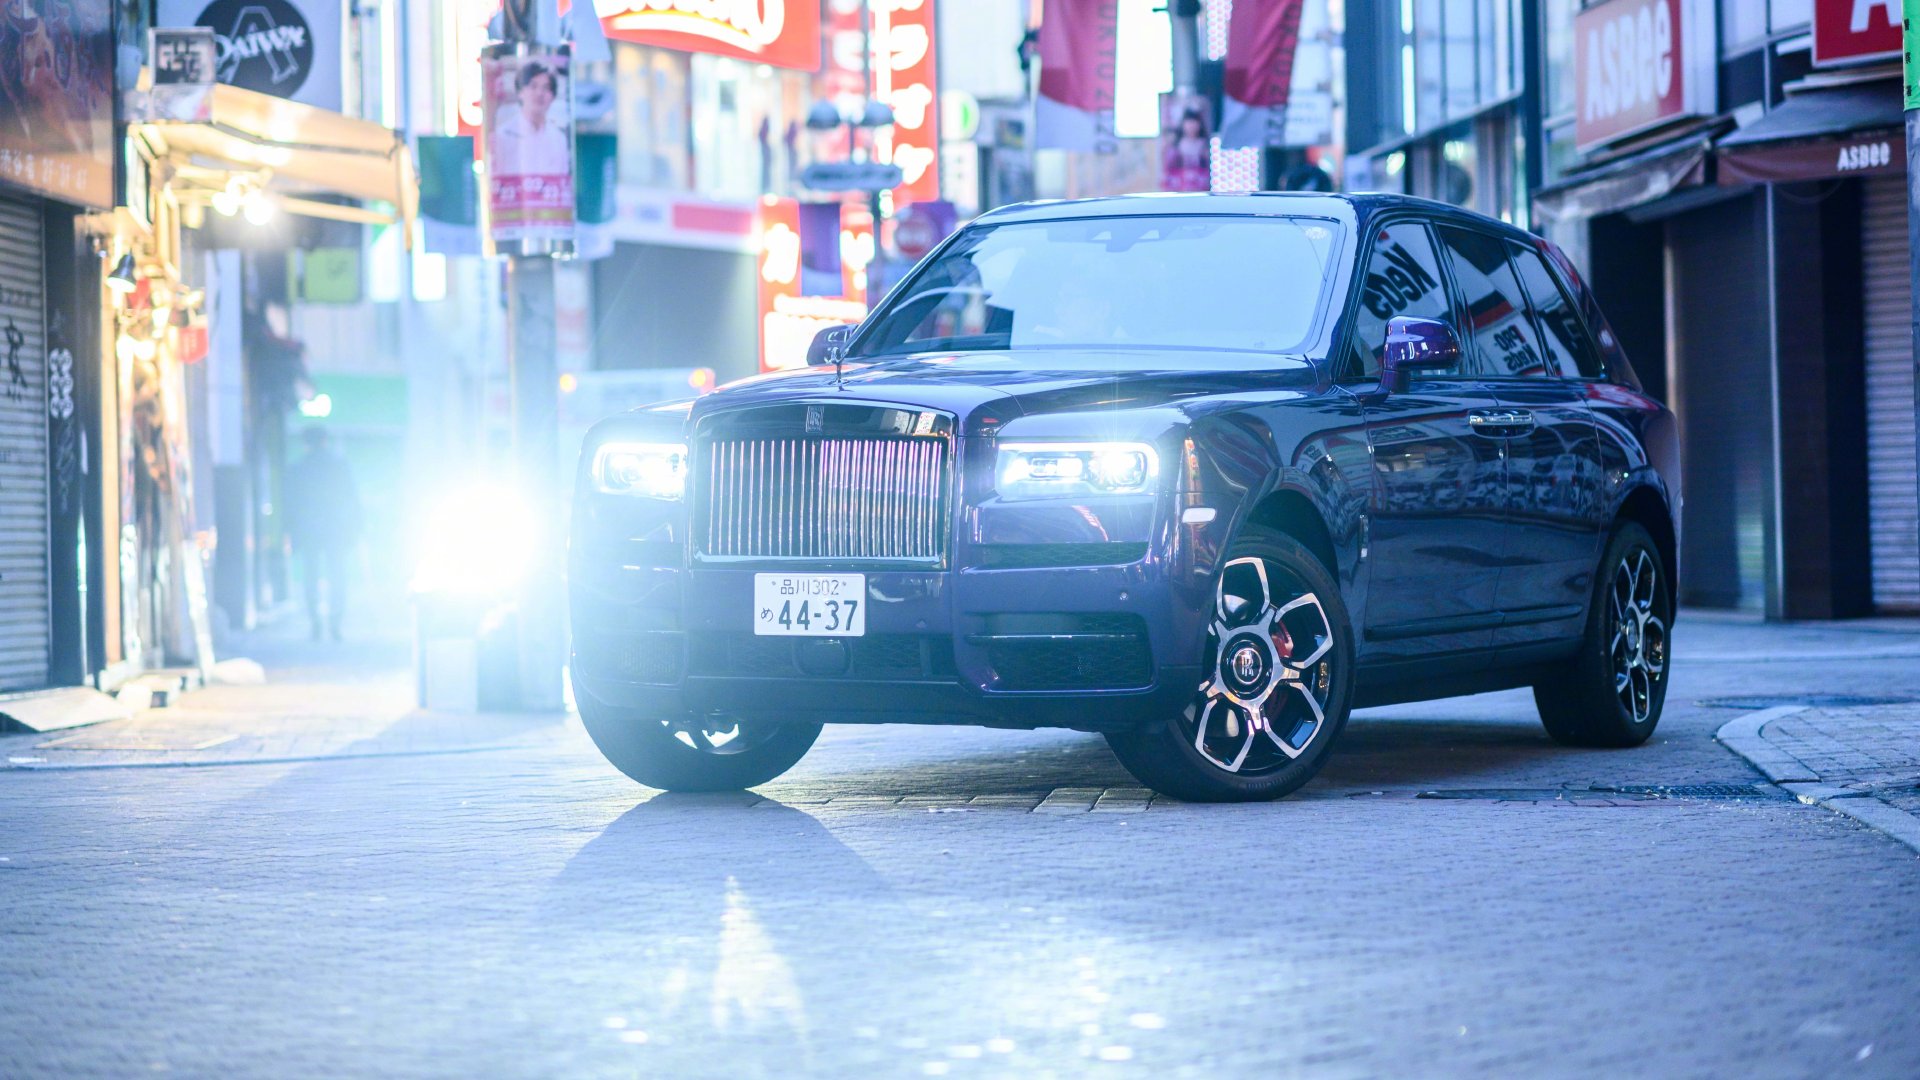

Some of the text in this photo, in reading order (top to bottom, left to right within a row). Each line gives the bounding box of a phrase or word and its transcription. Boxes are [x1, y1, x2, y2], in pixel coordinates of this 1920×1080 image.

[1585, 0, 1673, 125] ASBee
[1837, 142, 1891, 172] ASBee
[760, 599, 858, 631] め 44-37
